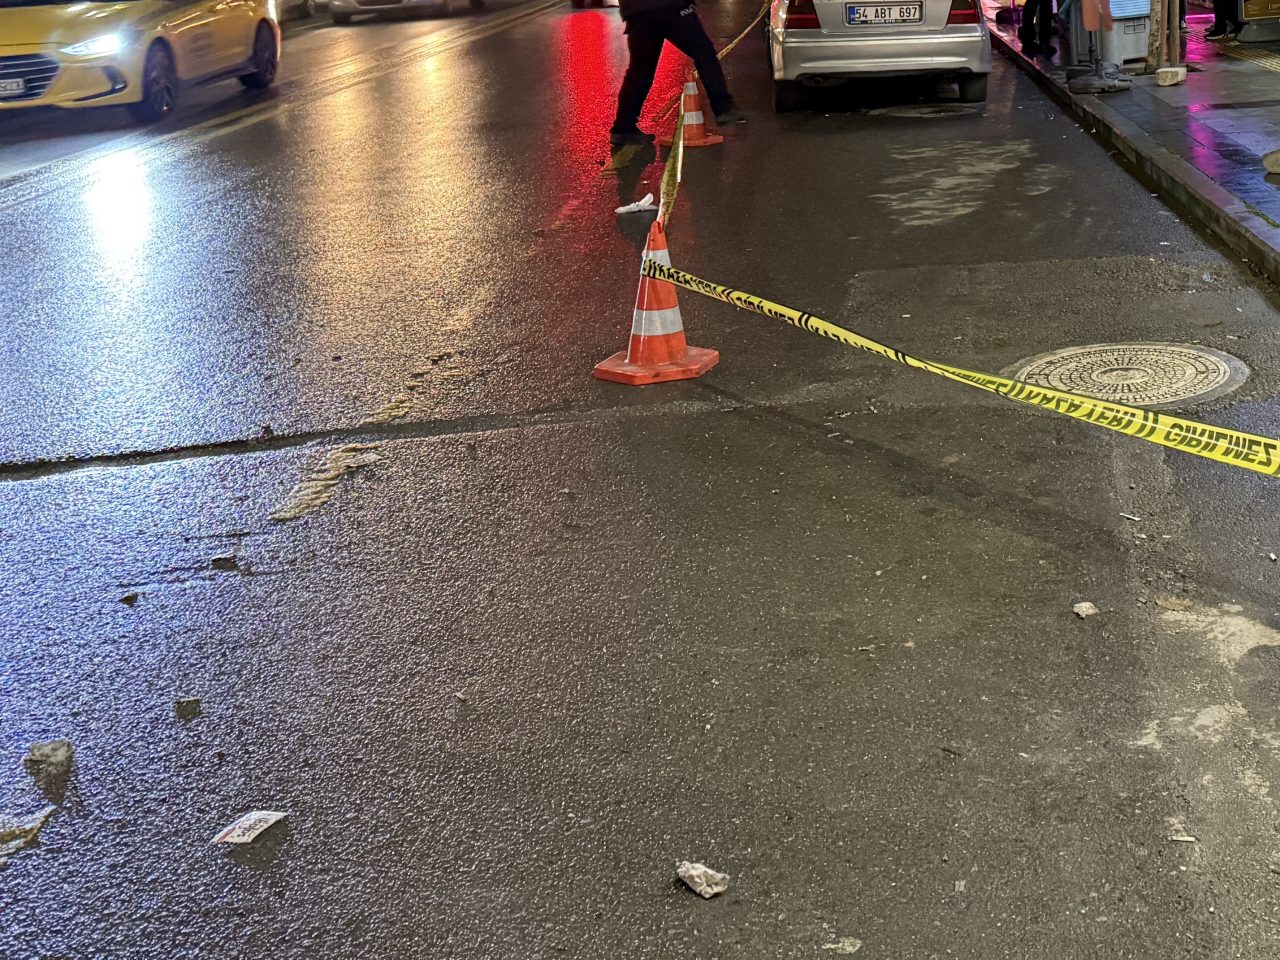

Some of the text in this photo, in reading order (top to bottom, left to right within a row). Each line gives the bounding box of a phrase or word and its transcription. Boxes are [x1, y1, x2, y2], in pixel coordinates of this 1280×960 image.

[856, 7, 917, 19] 54 ABT 697
